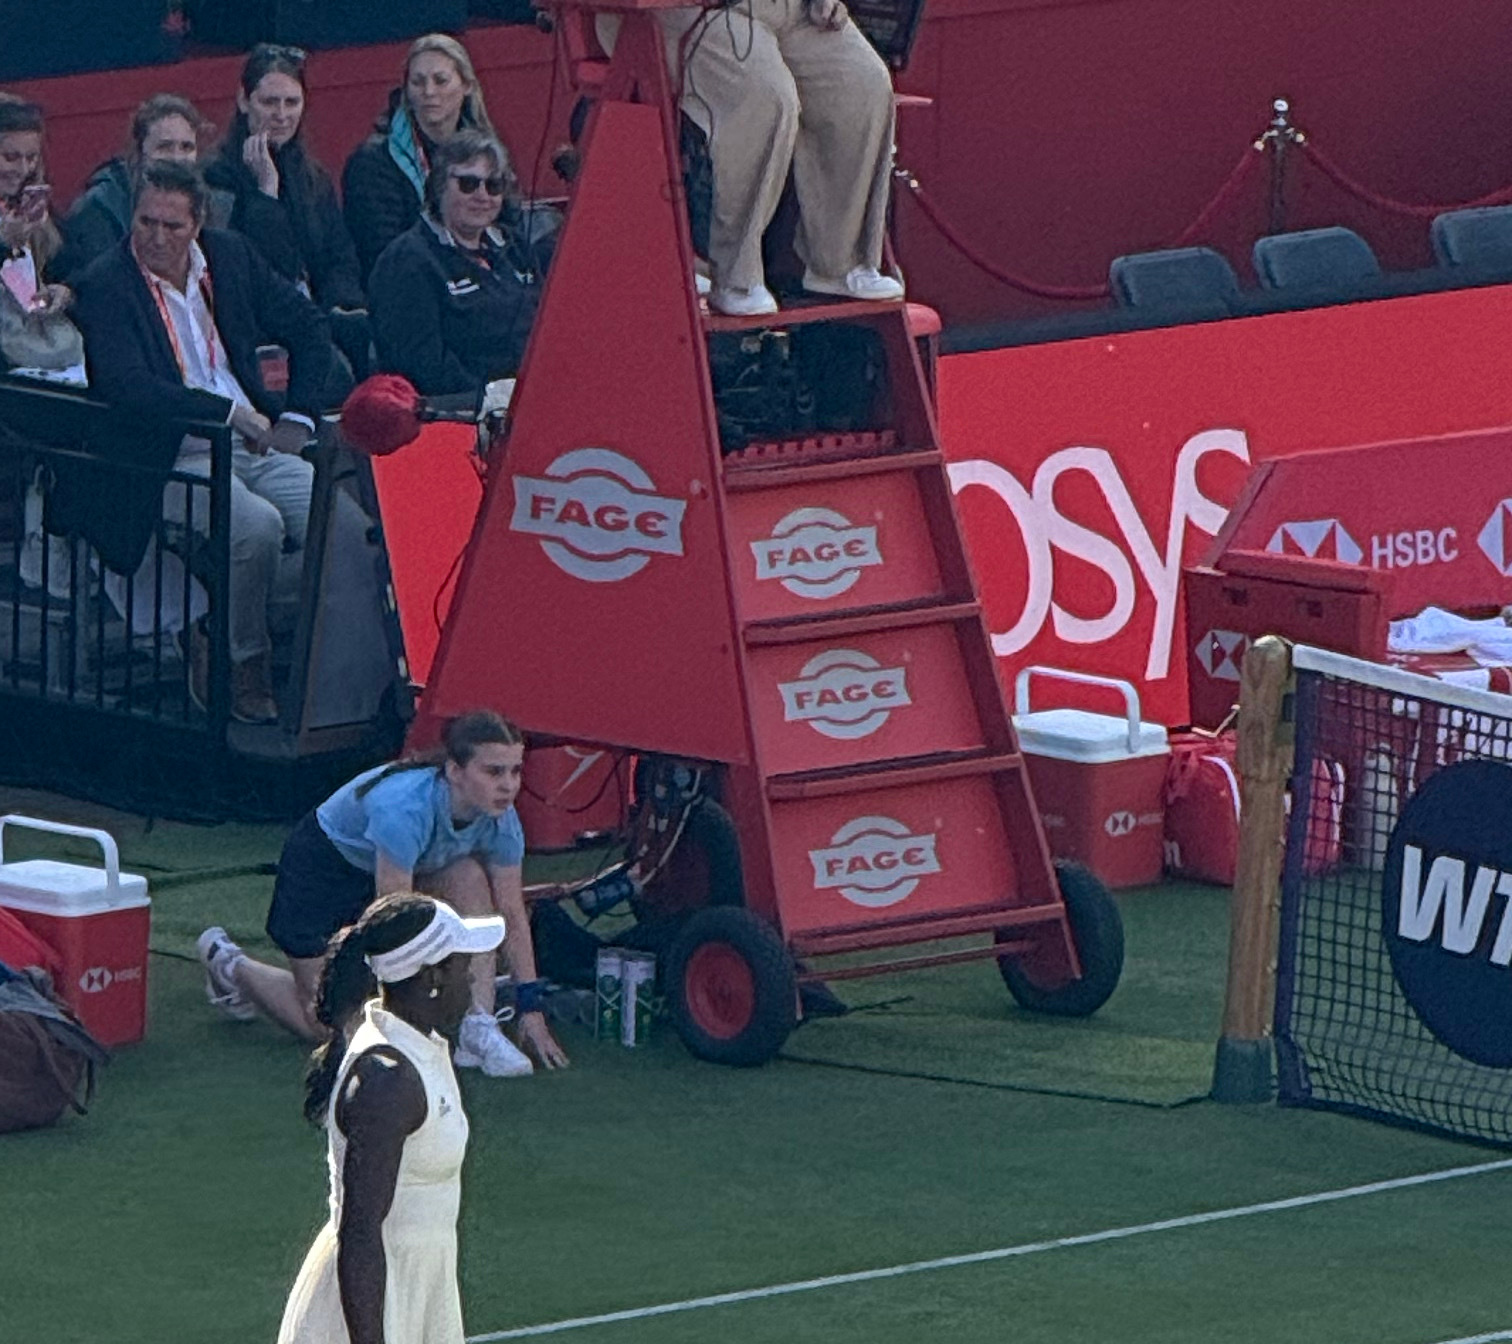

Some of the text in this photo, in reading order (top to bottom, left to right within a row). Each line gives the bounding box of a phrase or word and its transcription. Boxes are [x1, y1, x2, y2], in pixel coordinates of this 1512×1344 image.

[530, 494, 670, 539] FAGE
[767, 539, 869, 569] FAGE
[1371, 527, 1459, 570] HSBC
[794, 680, 897, 710] FAGE
[825, 847, 927, 877] FAGE
